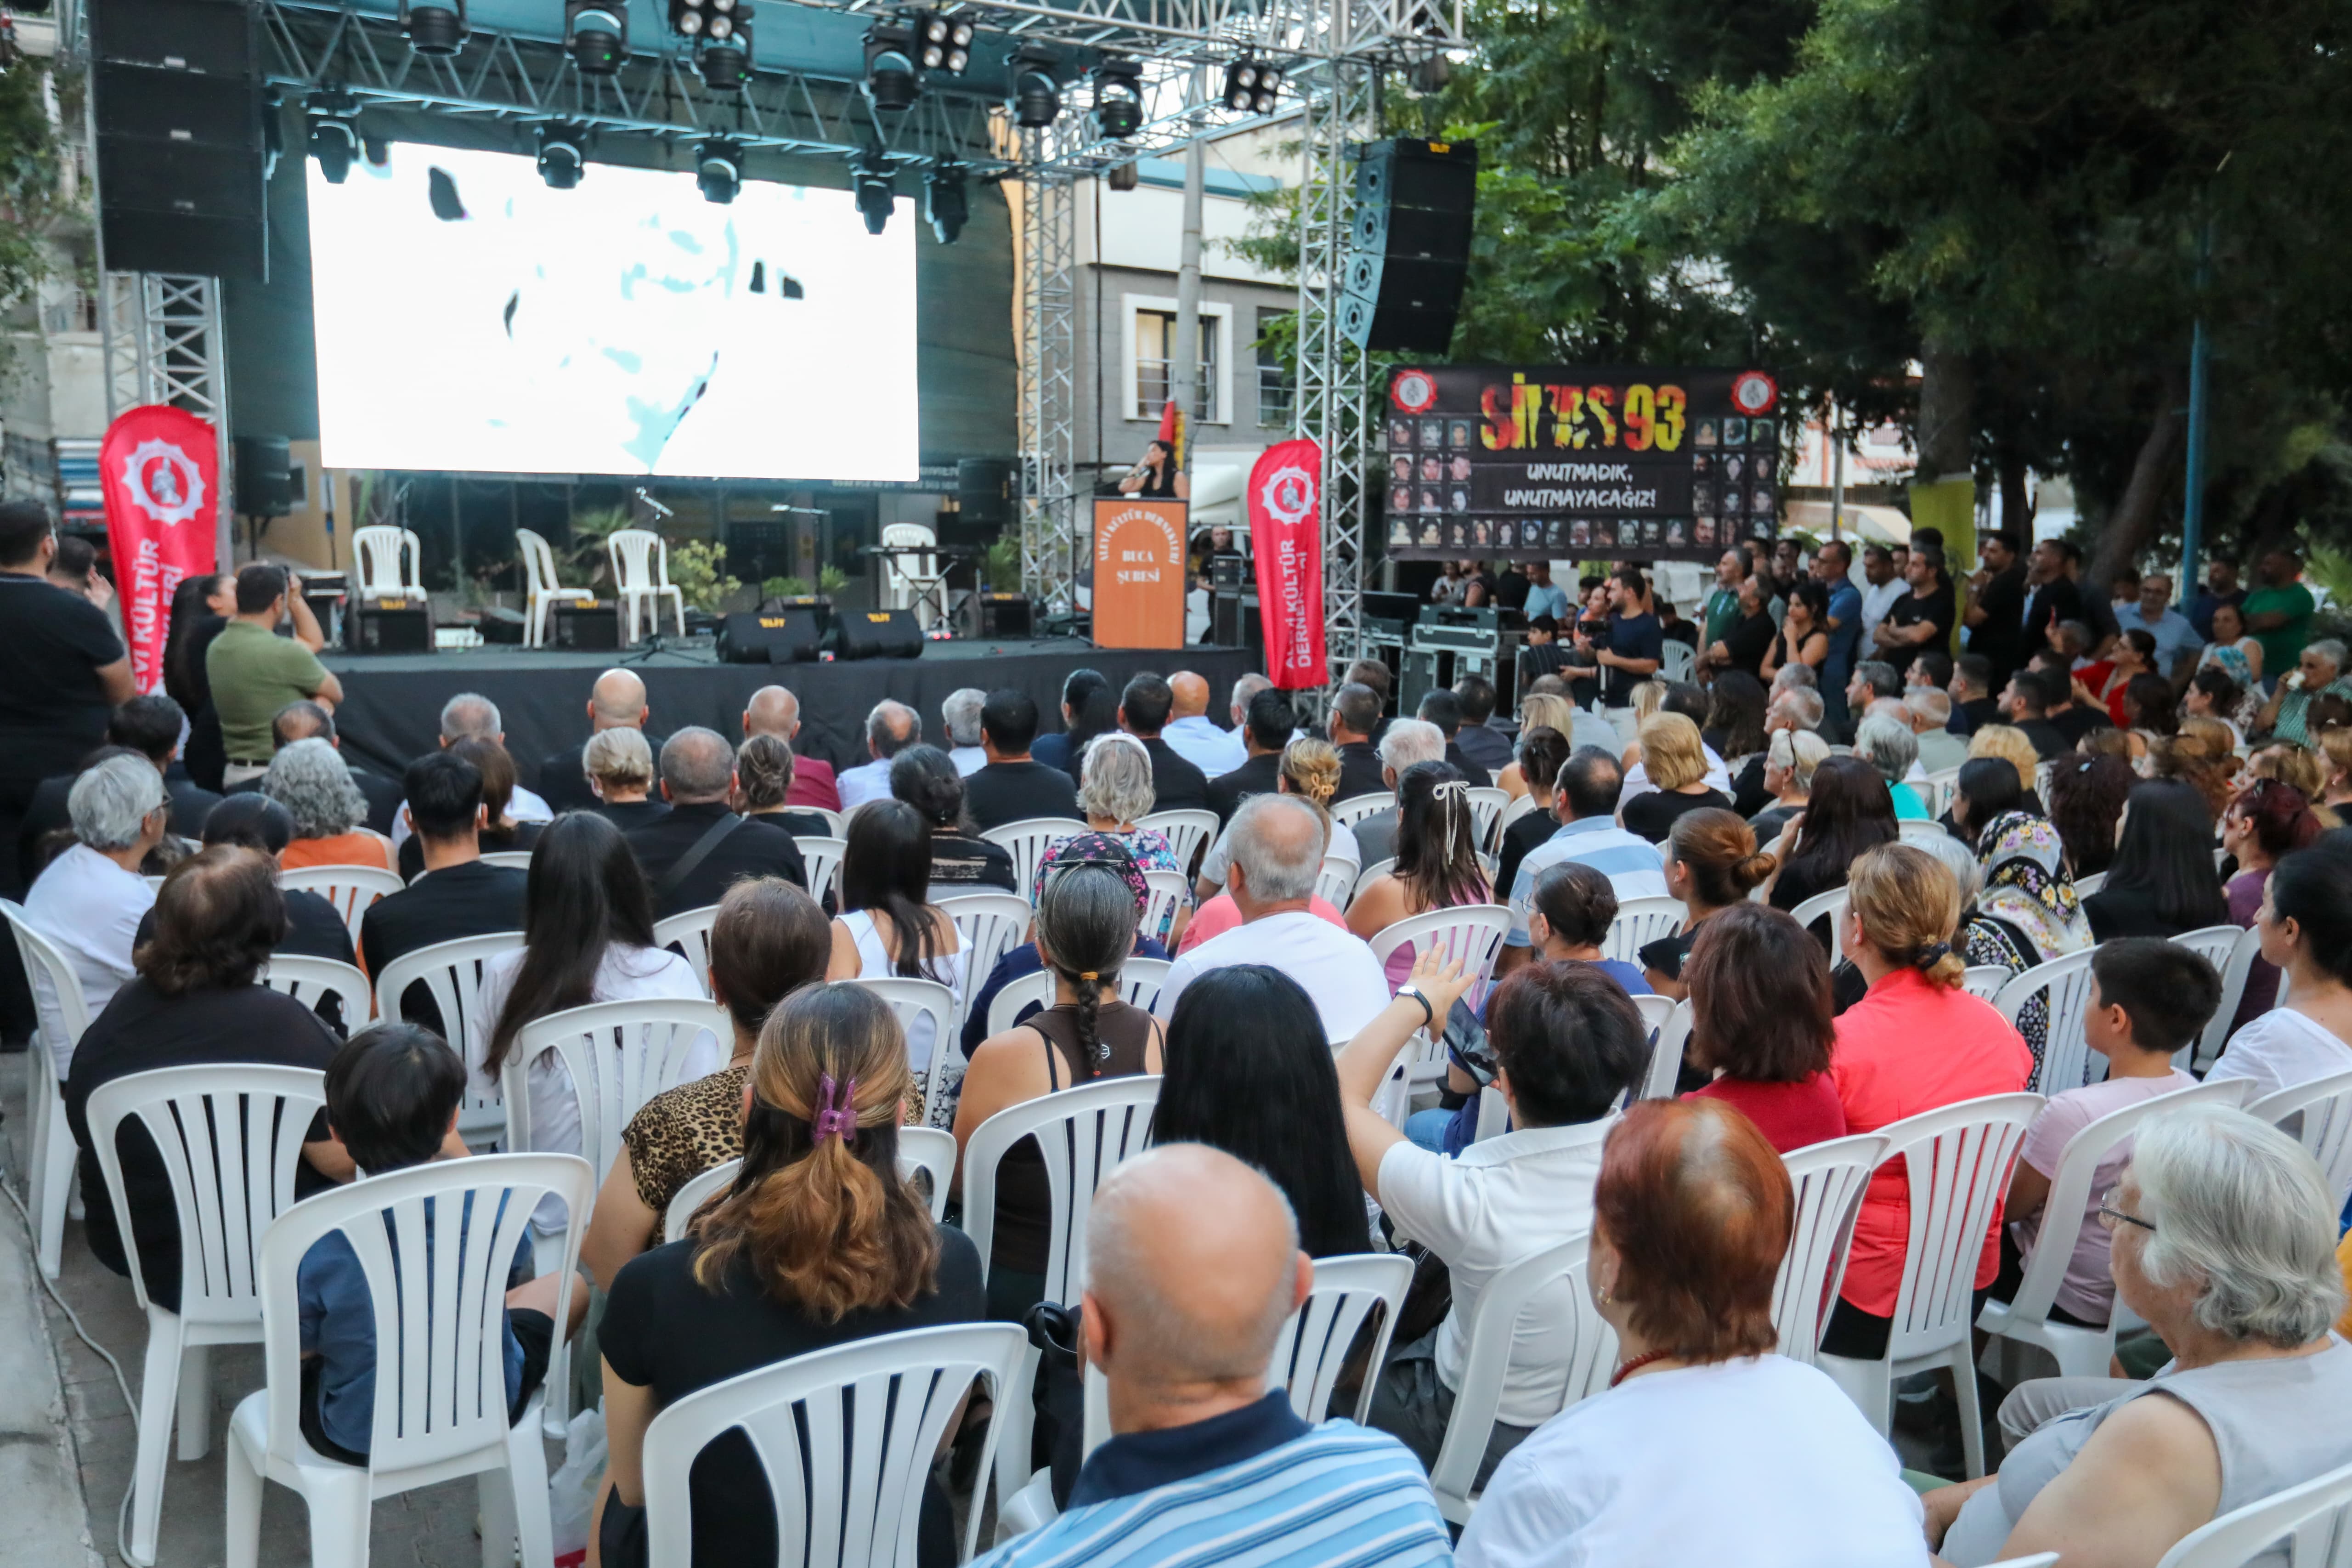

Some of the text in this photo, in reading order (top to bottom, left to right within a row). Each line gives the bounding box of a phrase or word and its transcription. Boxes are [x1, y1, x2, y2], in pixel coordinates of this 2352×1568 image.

[1623, 384, 1687, 452] 93
[1527, 464, 1633, 483] UNUTMADIK,
[1504, 485, 1657, 509] UNUTMAYACAĞIZ!
[1122, 550, 1154, 562] BUCA
[1117, 567, 1160, 584] ŞUBESİ
[1278, 539, 1299, 612] KÜLTÜR
[130, 538, 159, 643] KÜLTÜR
